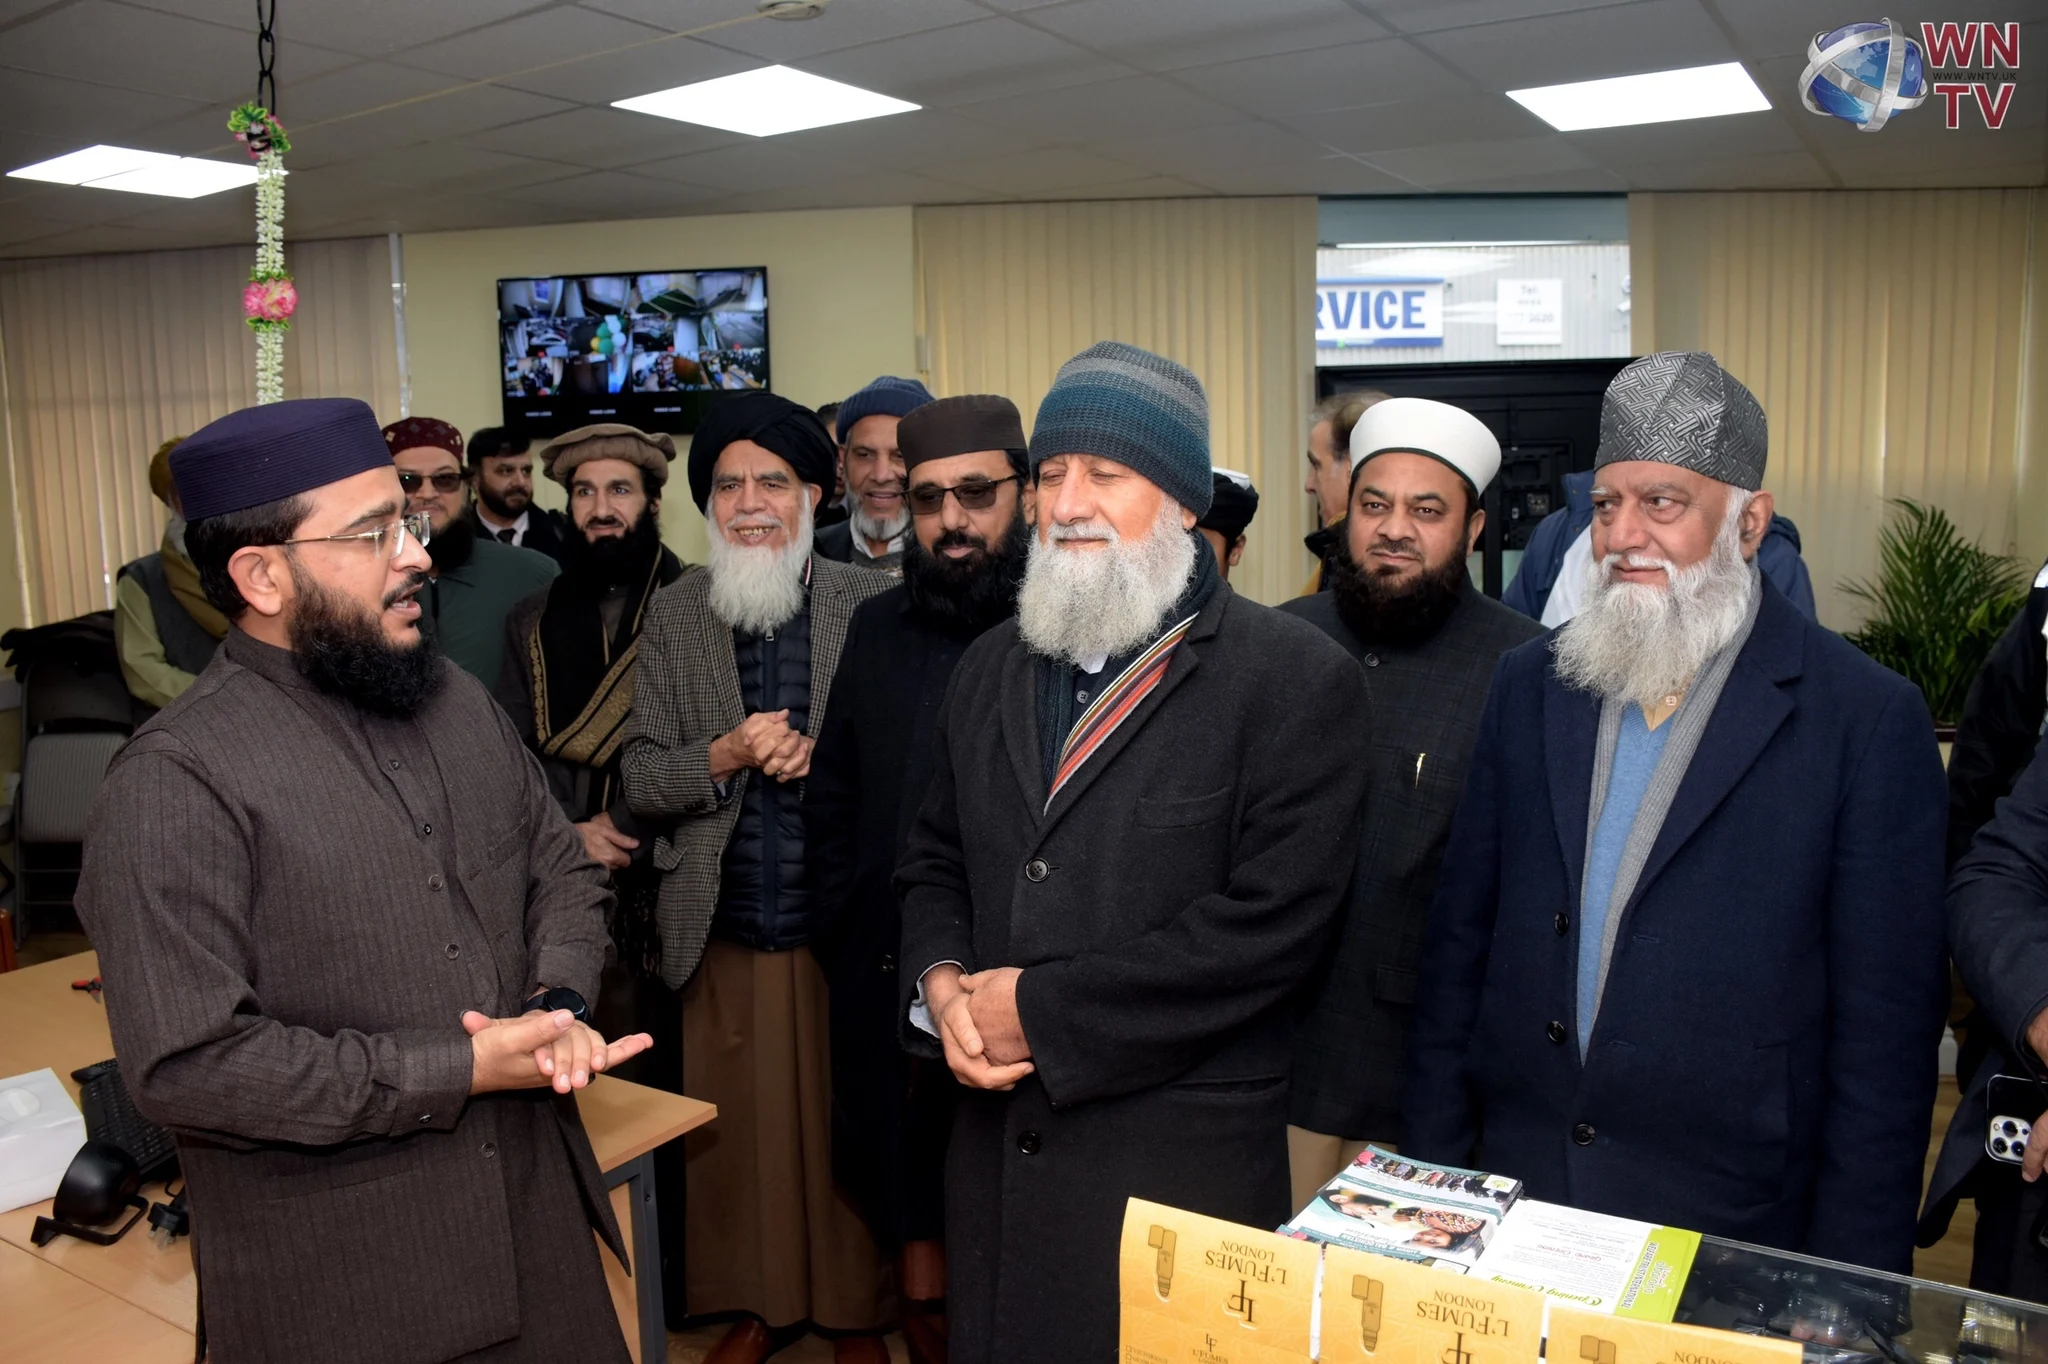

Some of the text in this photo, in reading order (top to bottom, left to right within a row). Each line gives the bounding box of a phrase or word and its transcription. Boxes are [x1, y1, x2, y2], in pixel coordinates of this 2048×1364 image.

[1221, 1240, 1275, 1263] LONDON
[1205, 1250, 1287, 1285] L'FUMES
[1433, 1289, 1495, 1314] LONDON
[1416, 1301, 1510, 1337] L'FUMES
